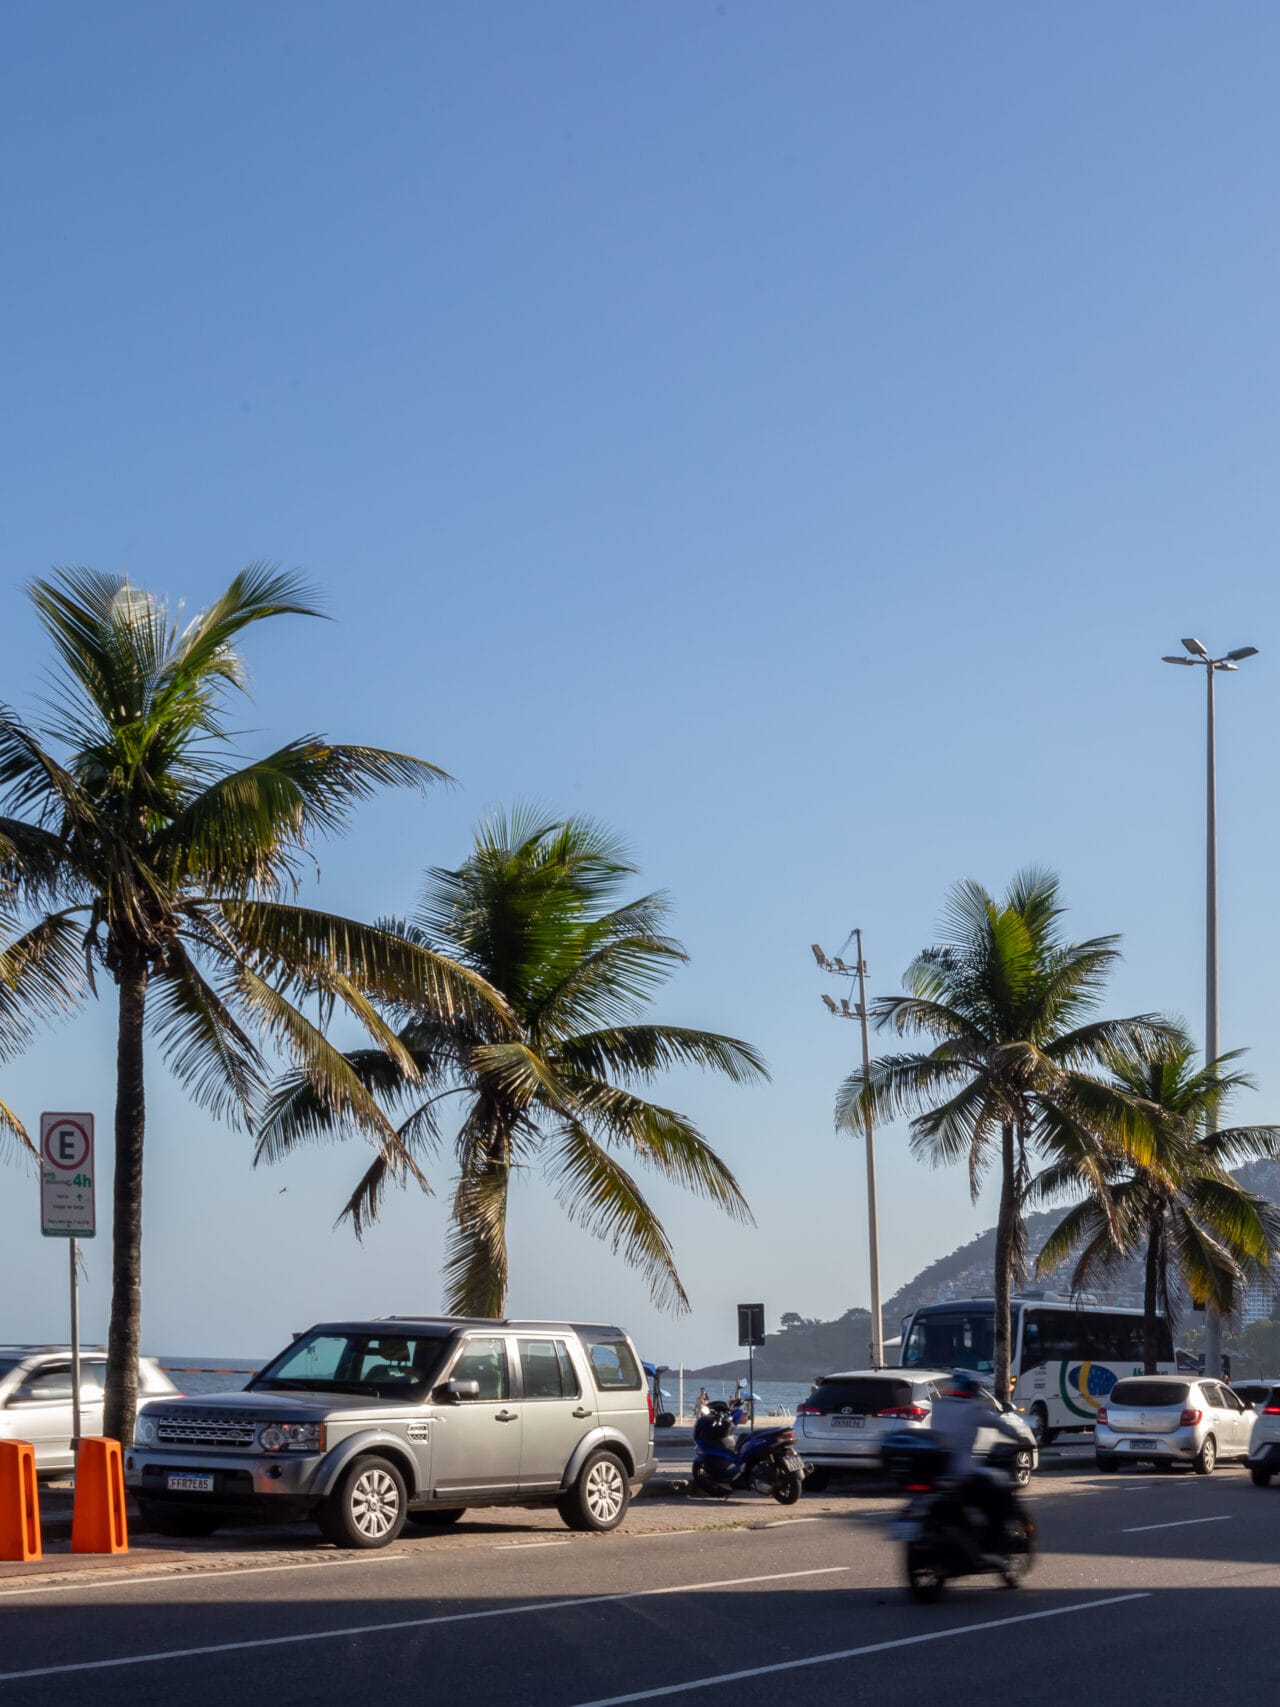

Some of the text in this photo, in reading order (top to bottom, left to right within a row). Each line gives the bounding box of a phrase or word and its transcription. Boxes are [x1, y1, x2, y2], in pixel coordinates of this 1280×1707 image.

[59, 1131, 74, 1159] E
[73, 1174, 91, 1188] 4h
[171, 1478, 209, 1489] FFR7E85
